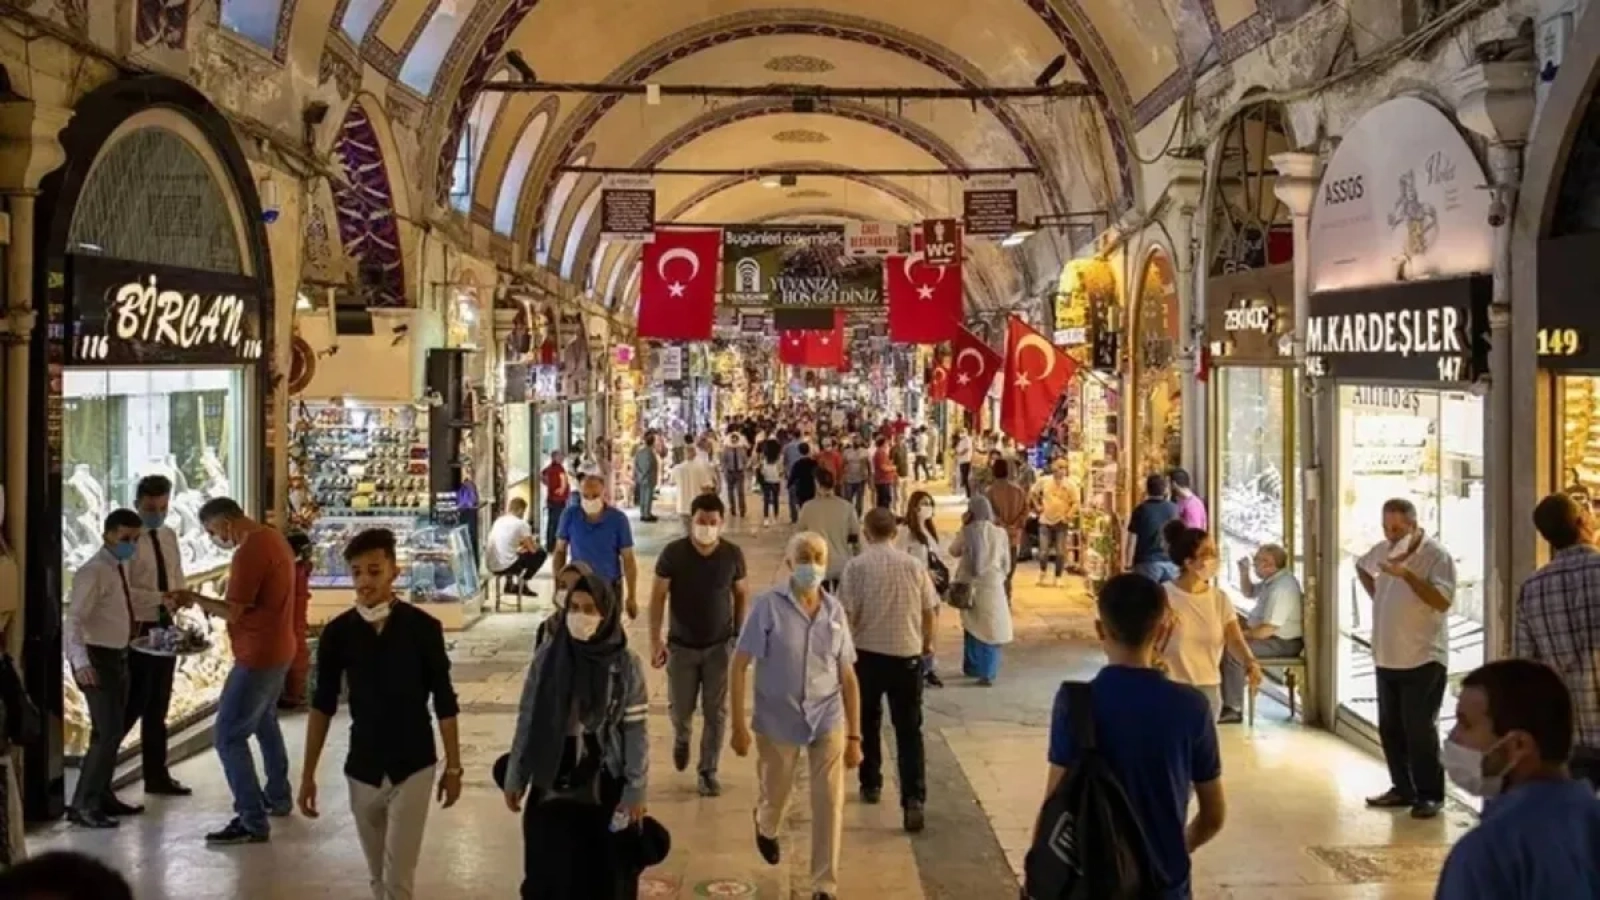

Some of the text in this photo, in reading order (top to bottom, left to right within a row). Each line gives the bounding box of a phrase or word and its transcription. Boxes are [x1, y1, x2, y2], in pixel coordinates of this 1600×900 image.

[1324, 175, 1365, 206] ASSOS
[725, 231, 782, 248] Bugünleri
[927, 243, 955, 257] WC
[782, 289, 811, 308] HOŞ
[811, 286, 878, 305] GELDİNİZ
[116, 274, 245, 349] BİRCAN
[1306, 306, 1461, 358] M.KARDEŞLER
[1536, 327, 1578, 356] 149
[81, 335, 109, 360] 116
[243, 340, 262, 359] 116
[1437, 356, 1462, 381] 147
